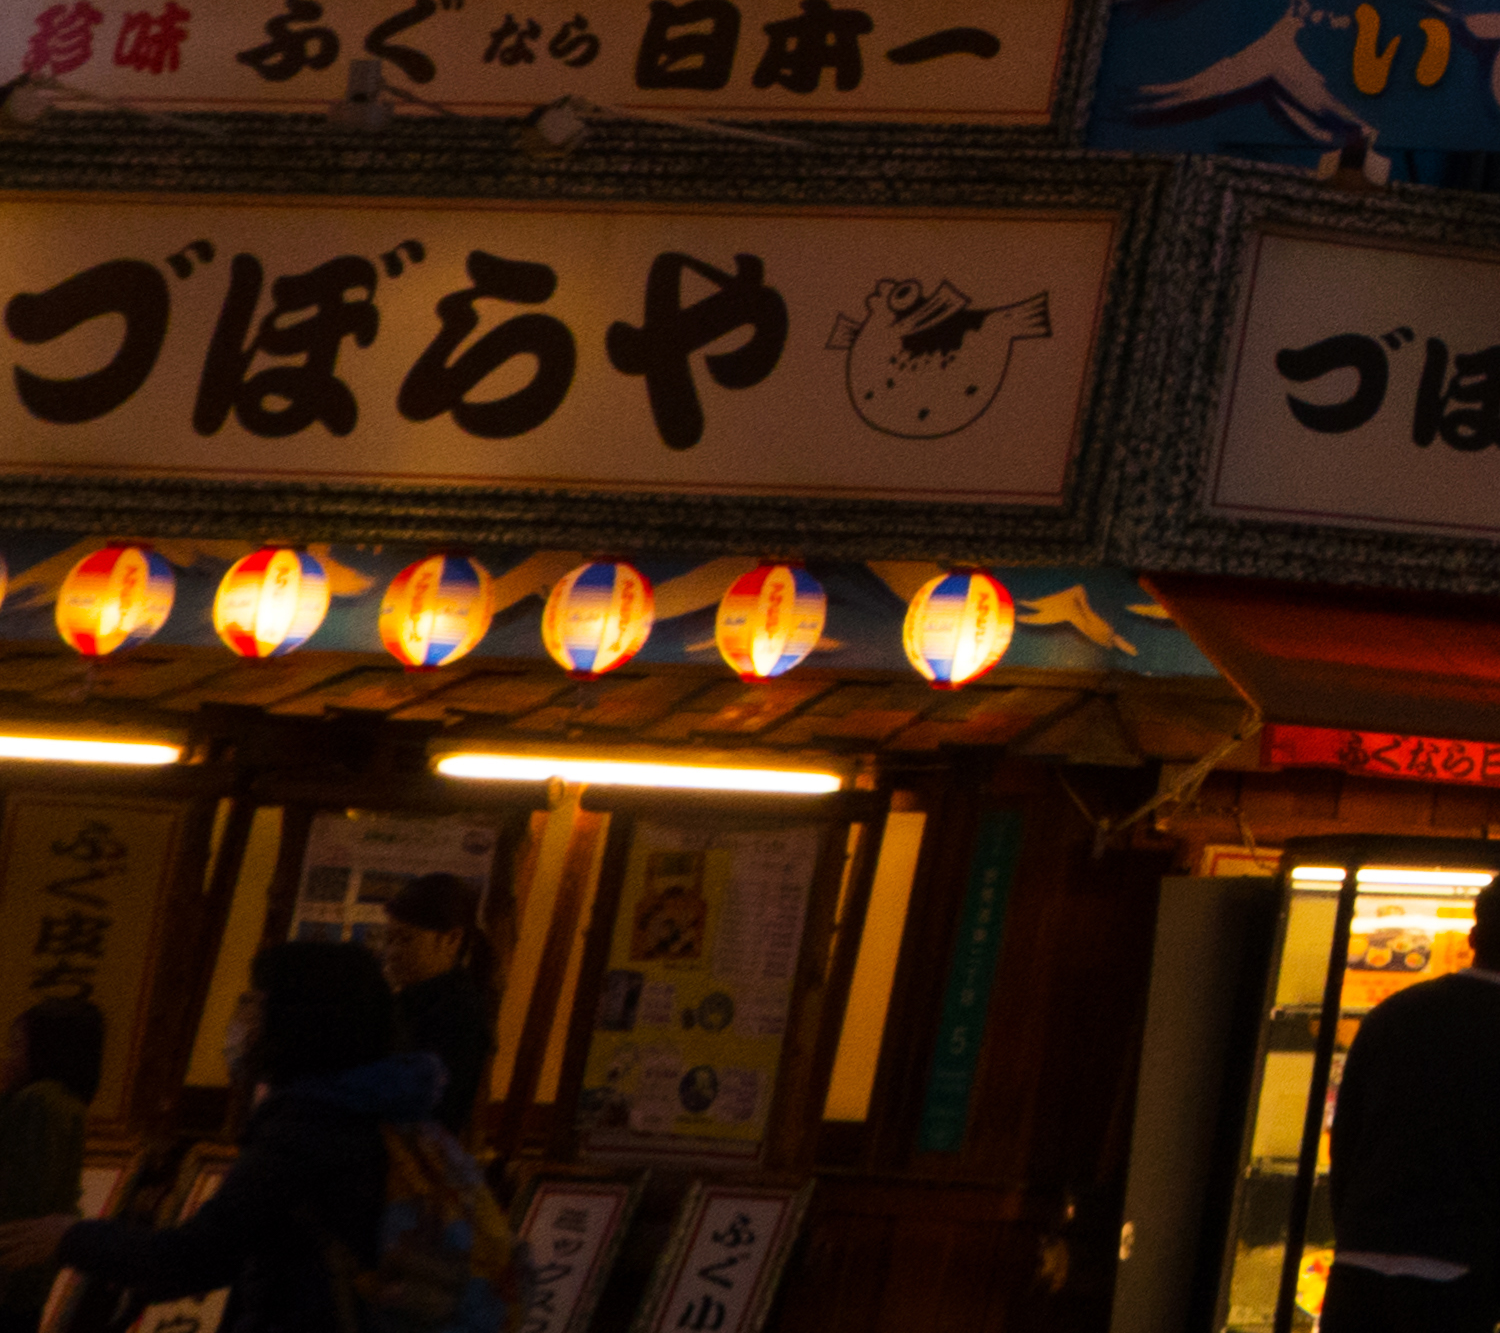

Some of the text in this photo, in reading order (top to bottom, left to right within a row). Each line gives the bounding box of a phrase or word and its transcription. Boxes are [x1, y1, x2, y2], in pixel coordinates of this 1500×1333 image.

[22, 2, 191, 79] 珍味
[4, 239, 790, 451] づぼらや
